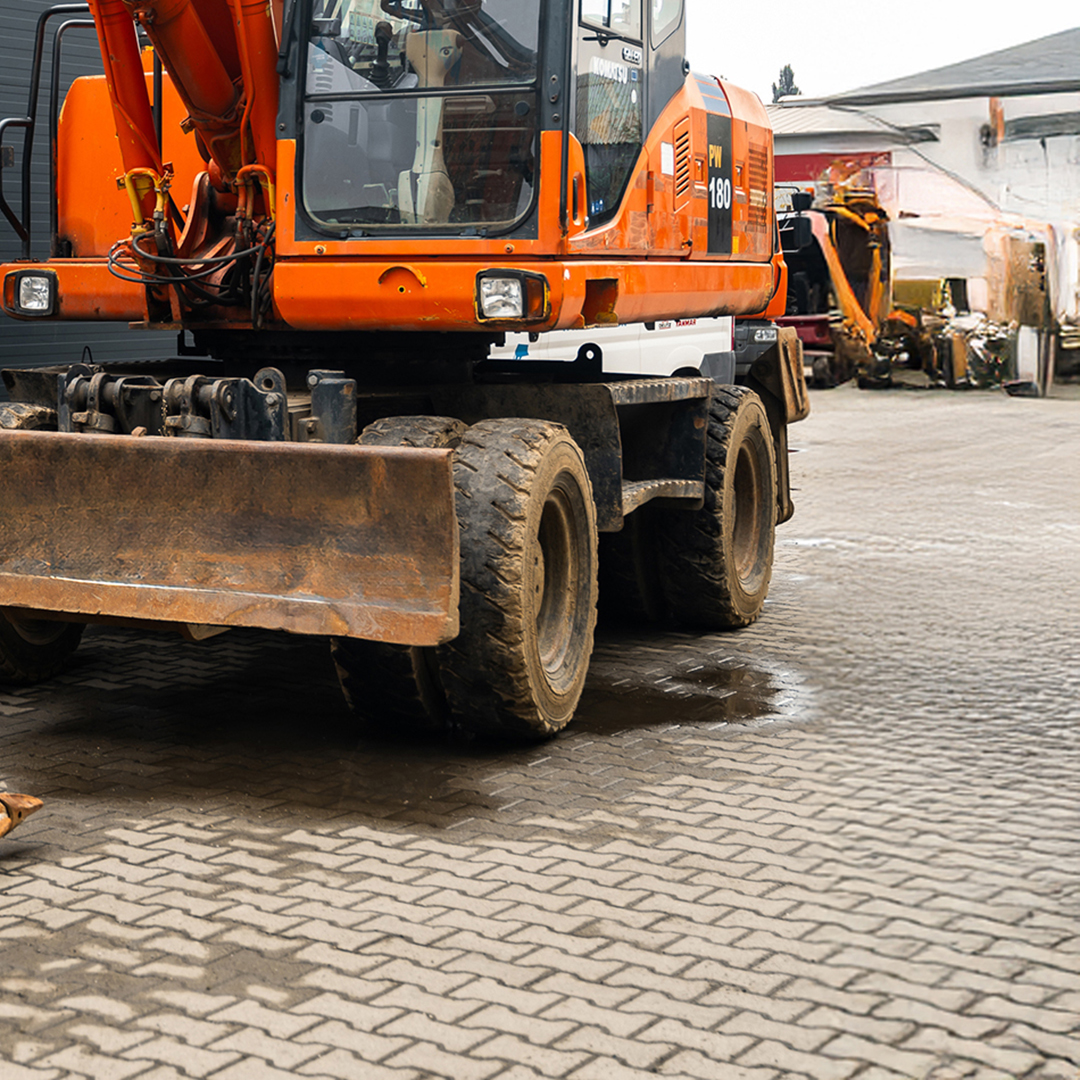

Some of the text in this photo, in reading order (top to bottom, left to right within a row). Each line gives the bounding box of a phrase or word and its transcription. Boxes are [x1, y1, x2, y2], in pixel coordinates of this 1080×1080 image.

[592, 56, 628, 85] KOMATSU
[709, 144, 722, 168] PW
[709, 176, 731, 210] 180
